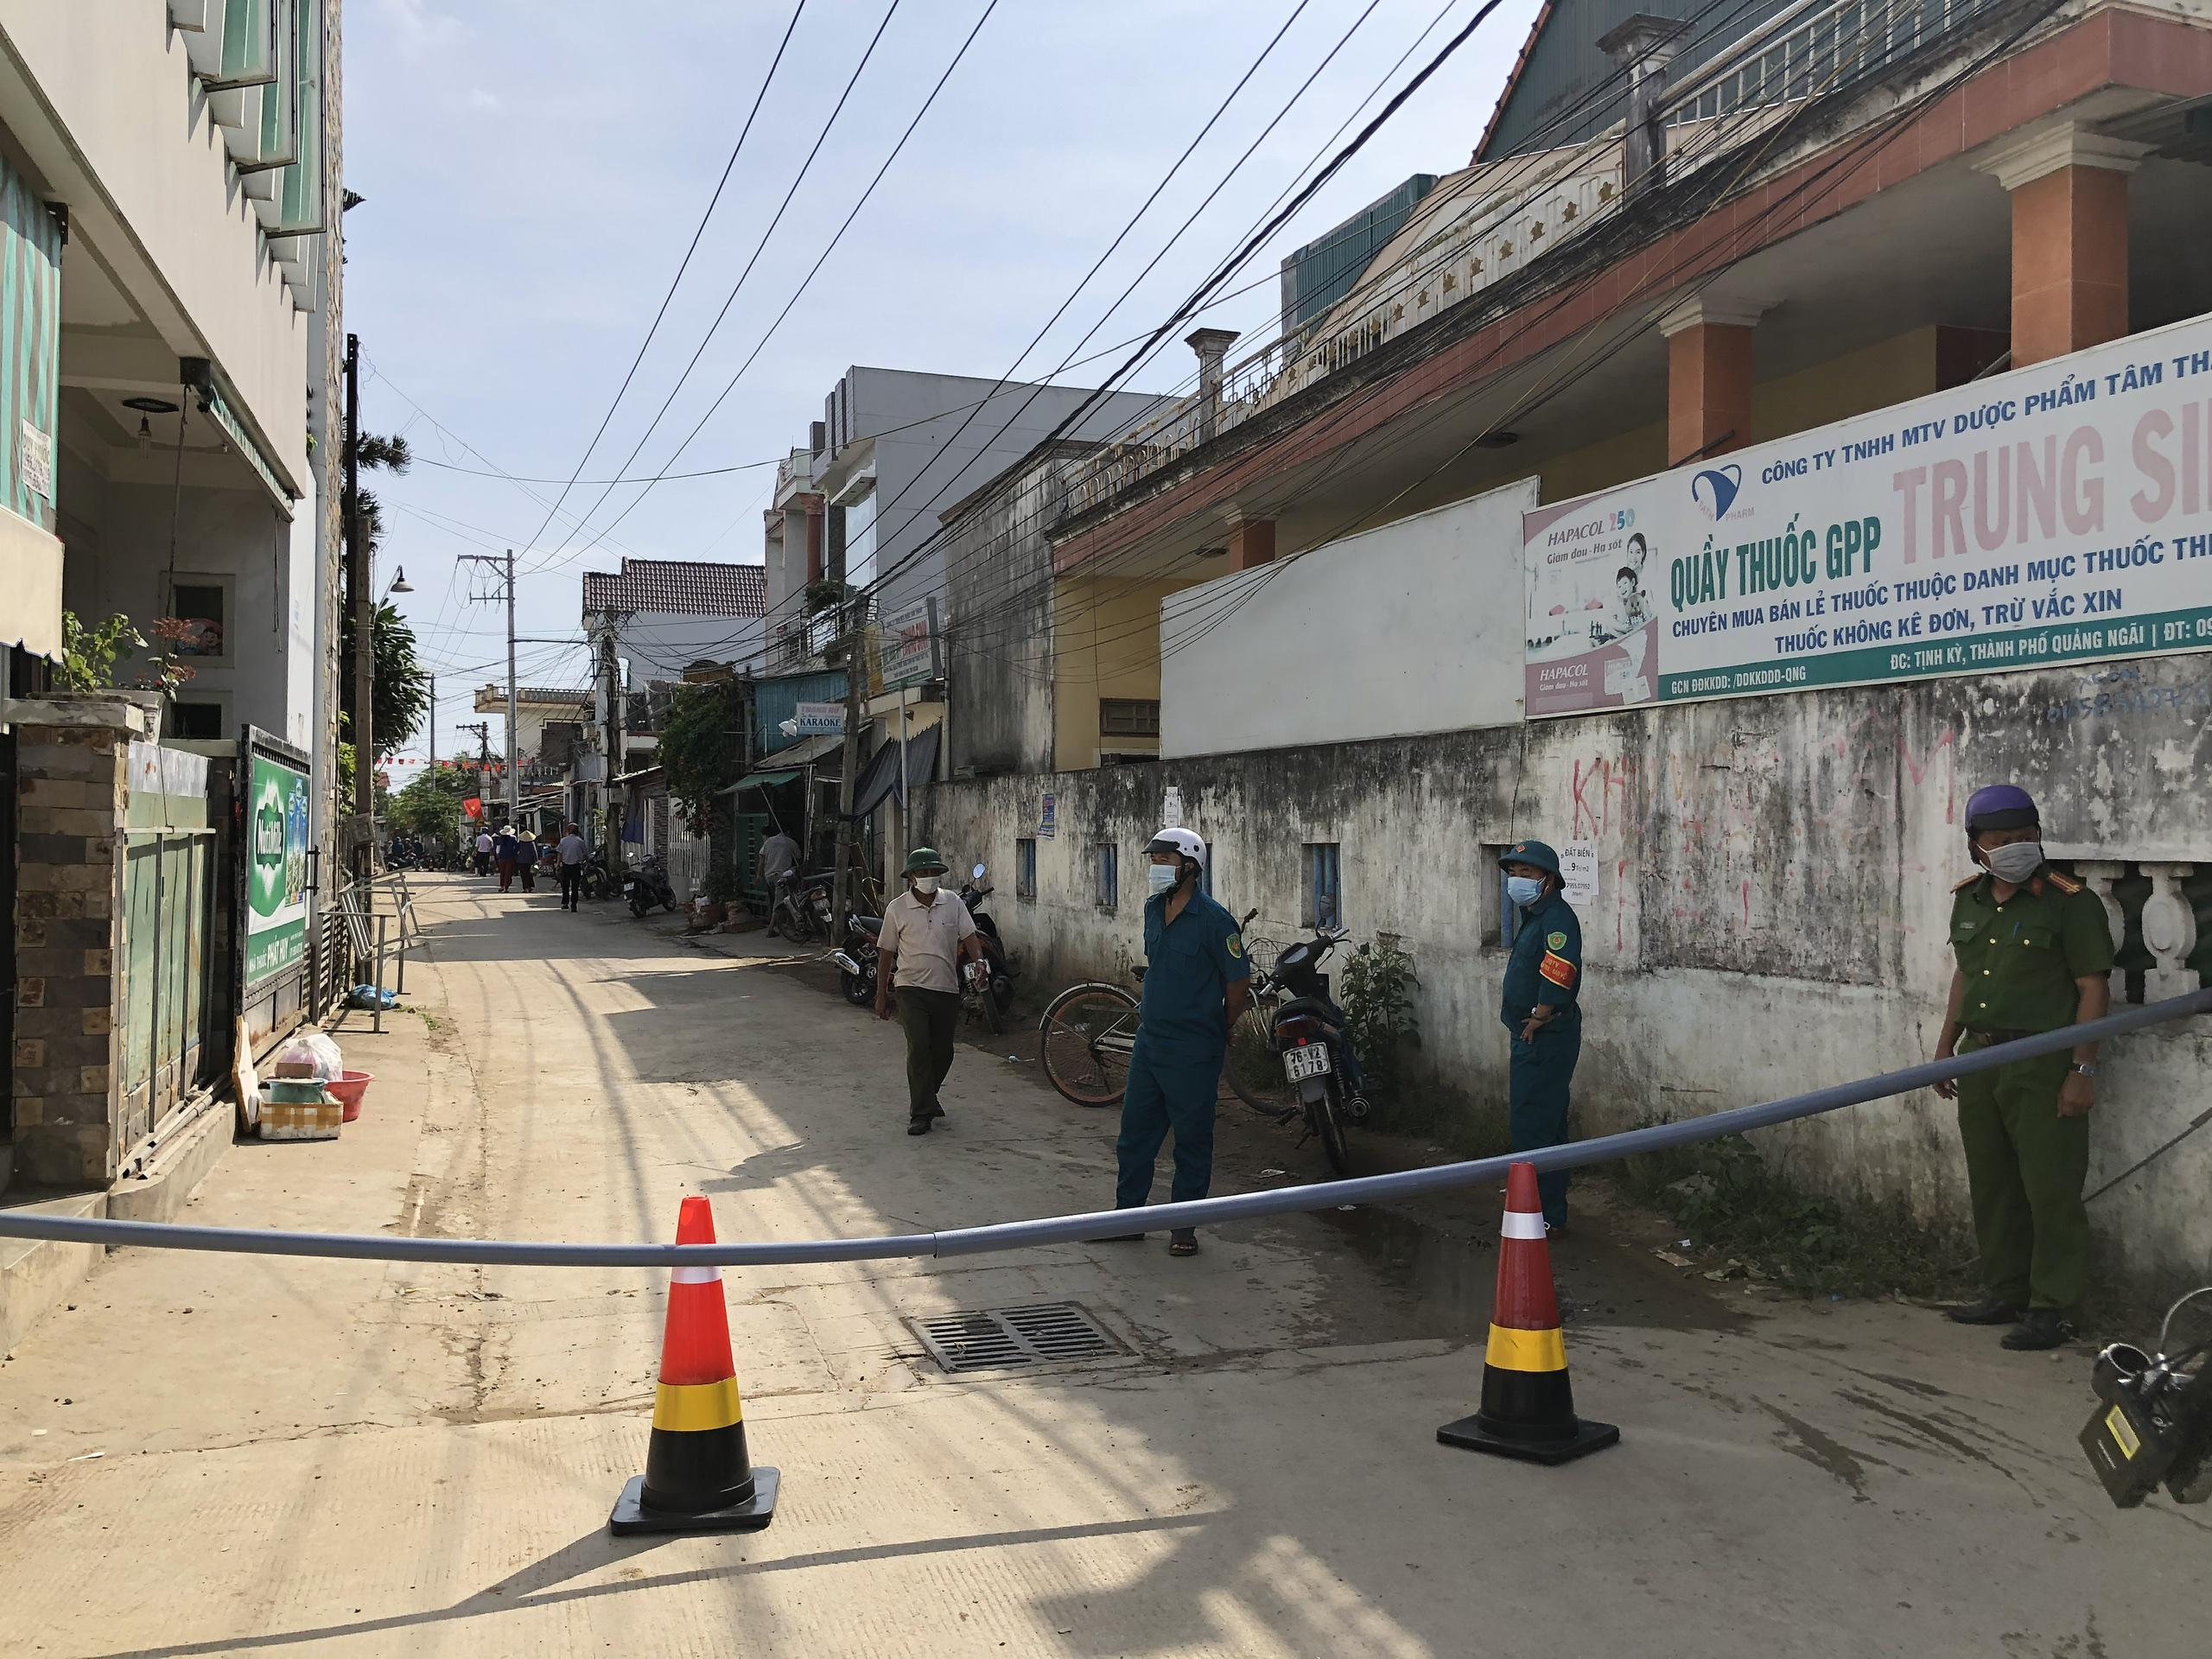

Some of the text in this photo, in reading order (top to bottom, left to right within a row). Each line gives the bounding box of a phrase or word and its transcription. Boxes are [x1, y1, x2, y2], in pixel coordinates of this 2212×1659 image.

[1762, 350, 2212, 484] CÔNG TY TNHH MTV DƯỢC PHẨM TÂM TH
[1699, 500, 1755, 522] TATH PHARM
[1892, 397, 2212, 565] TRUNG SI
[1547, 508, 1636, 547] HAPACOL 250
[1571, 548, 1587, 560] đau
[1670, 512, 1881, 613] QUẦY THUỐC GPP
[1672, 611, 1727, 638] CHUYÊN
[1732, 607, 1764, 628] MUA
[1770, 599, 1801, 622] BÁN
[1806, 590, 1826, 617] LẺ
[1831, 580, 1888, 613] THUỐC
[1893, 572, 1955, 603] THUỘC
[1963, 564, 2018, 592] DANH
[2027, 555, 2075, 583] MỤC
[2083, 534, 2164, 574] THUỐC
[1775, 587, 2122, 653] THUỐC KHÔNG KÊ ĐƠN, TRỪ VẮC XIN
[1540, 664, 1588, 682] HAPACOL
[1671, 678, 1689, 694] GCN
[1890, 654, 1911, 671] ĐC:
[1914, 649, 1943, 671] TỊNH
[1947, 643, 1967, 665] KỲ,
[1969, 639, 2014, 660] THÀNH
[2018, 631, 2048, 656] PHỐ
[2052, 628, 2102, 654] QUẢNG
[2107, 622, 2144, 647] NGÃI
[2164, 620, 2190, 641] ĐT:
[800, 718, 841, 727] KARAOKE
